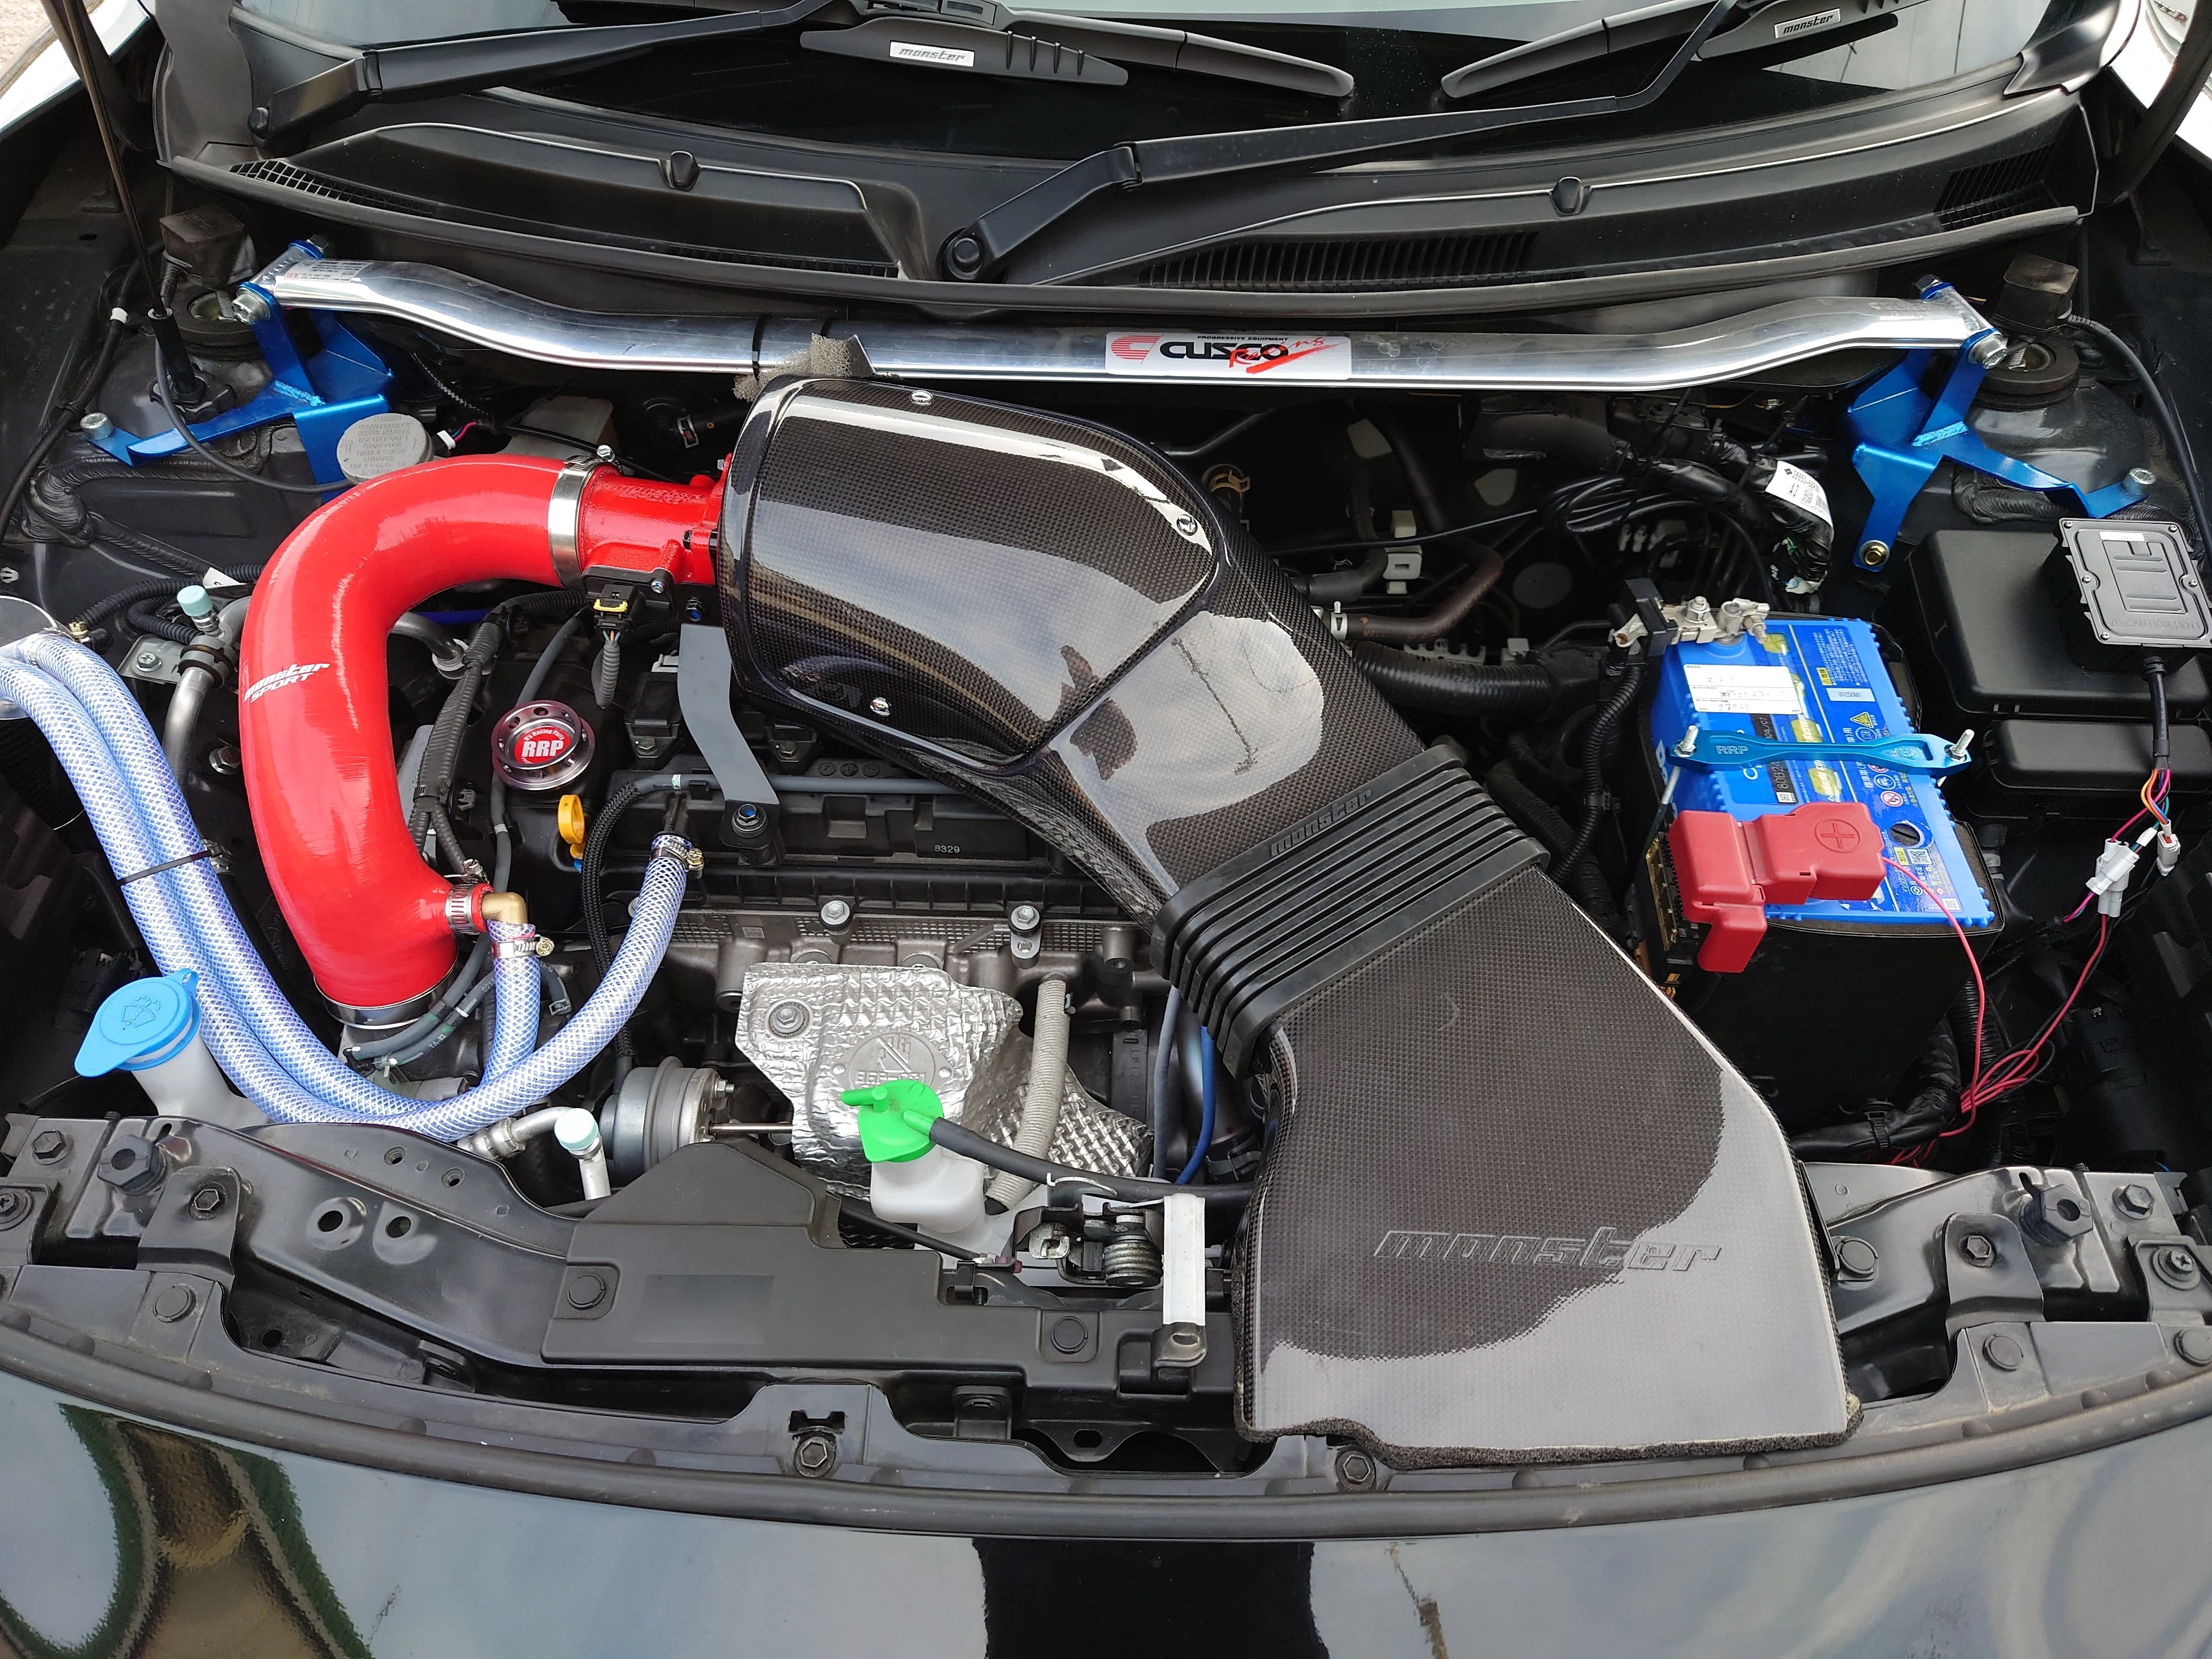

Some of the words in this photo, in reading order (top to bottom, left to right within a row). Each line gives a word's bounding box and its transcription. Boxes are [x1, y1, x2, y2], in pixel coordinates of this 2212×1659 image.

[1783, 15, 1833, 33] monster
[899, 48, 965, 61] monster
[1159, 341, 1289, 360] CUSCO
[2125, 619, 2171, 628] CAUTION
[244, 663, 330, 702] monster
[250, 673, 313, 703] SPORT
[553, 730, 566, 741] Parts
[522, 740, 564, 757] RRP
[1716, 746, 1748, 754] RRP
[1271, 789, 1372, 856] monster
[934, 845, 960, 853] 8329
[1373, 1227, 1722, 1272] monster
